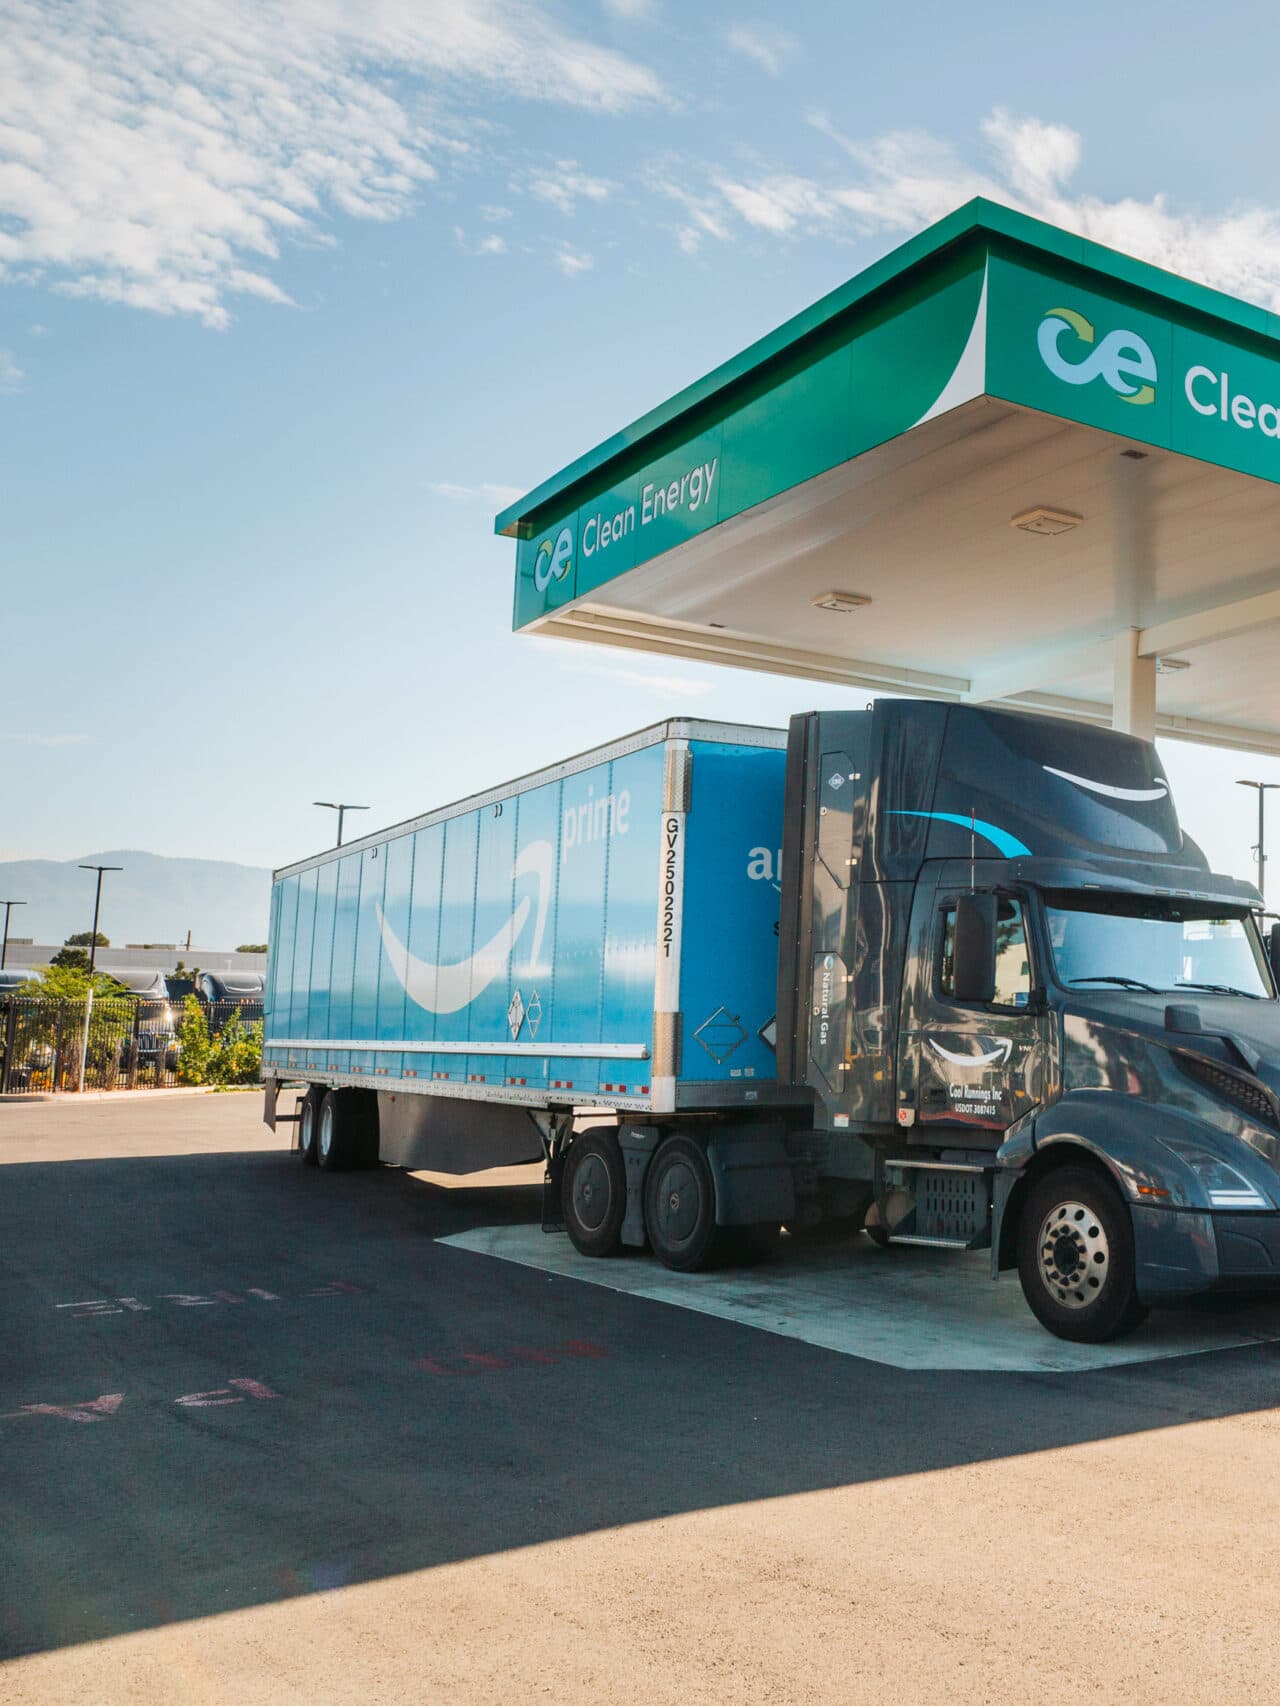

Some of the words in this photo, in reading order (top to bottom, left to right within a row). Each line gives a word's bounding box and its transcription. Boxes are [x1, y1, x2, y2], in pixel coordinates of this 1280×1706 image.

[582, 505, 636, 557] Clean
[640, 456, 718, 526] Energy
[562, 784, 631, 865] prime
[663, 818, 679, 957] GV2502221
[821, 972, 831, 1019] Natural
[820, 1022, 829, 1045] Gas
[949, 1083, 963, 1099] Cool
[964, 1084, 992, 1103] Runnings
[992, 1086, 1003, 1101] Inc
[955, 1103, 973, 1114] USDOT
